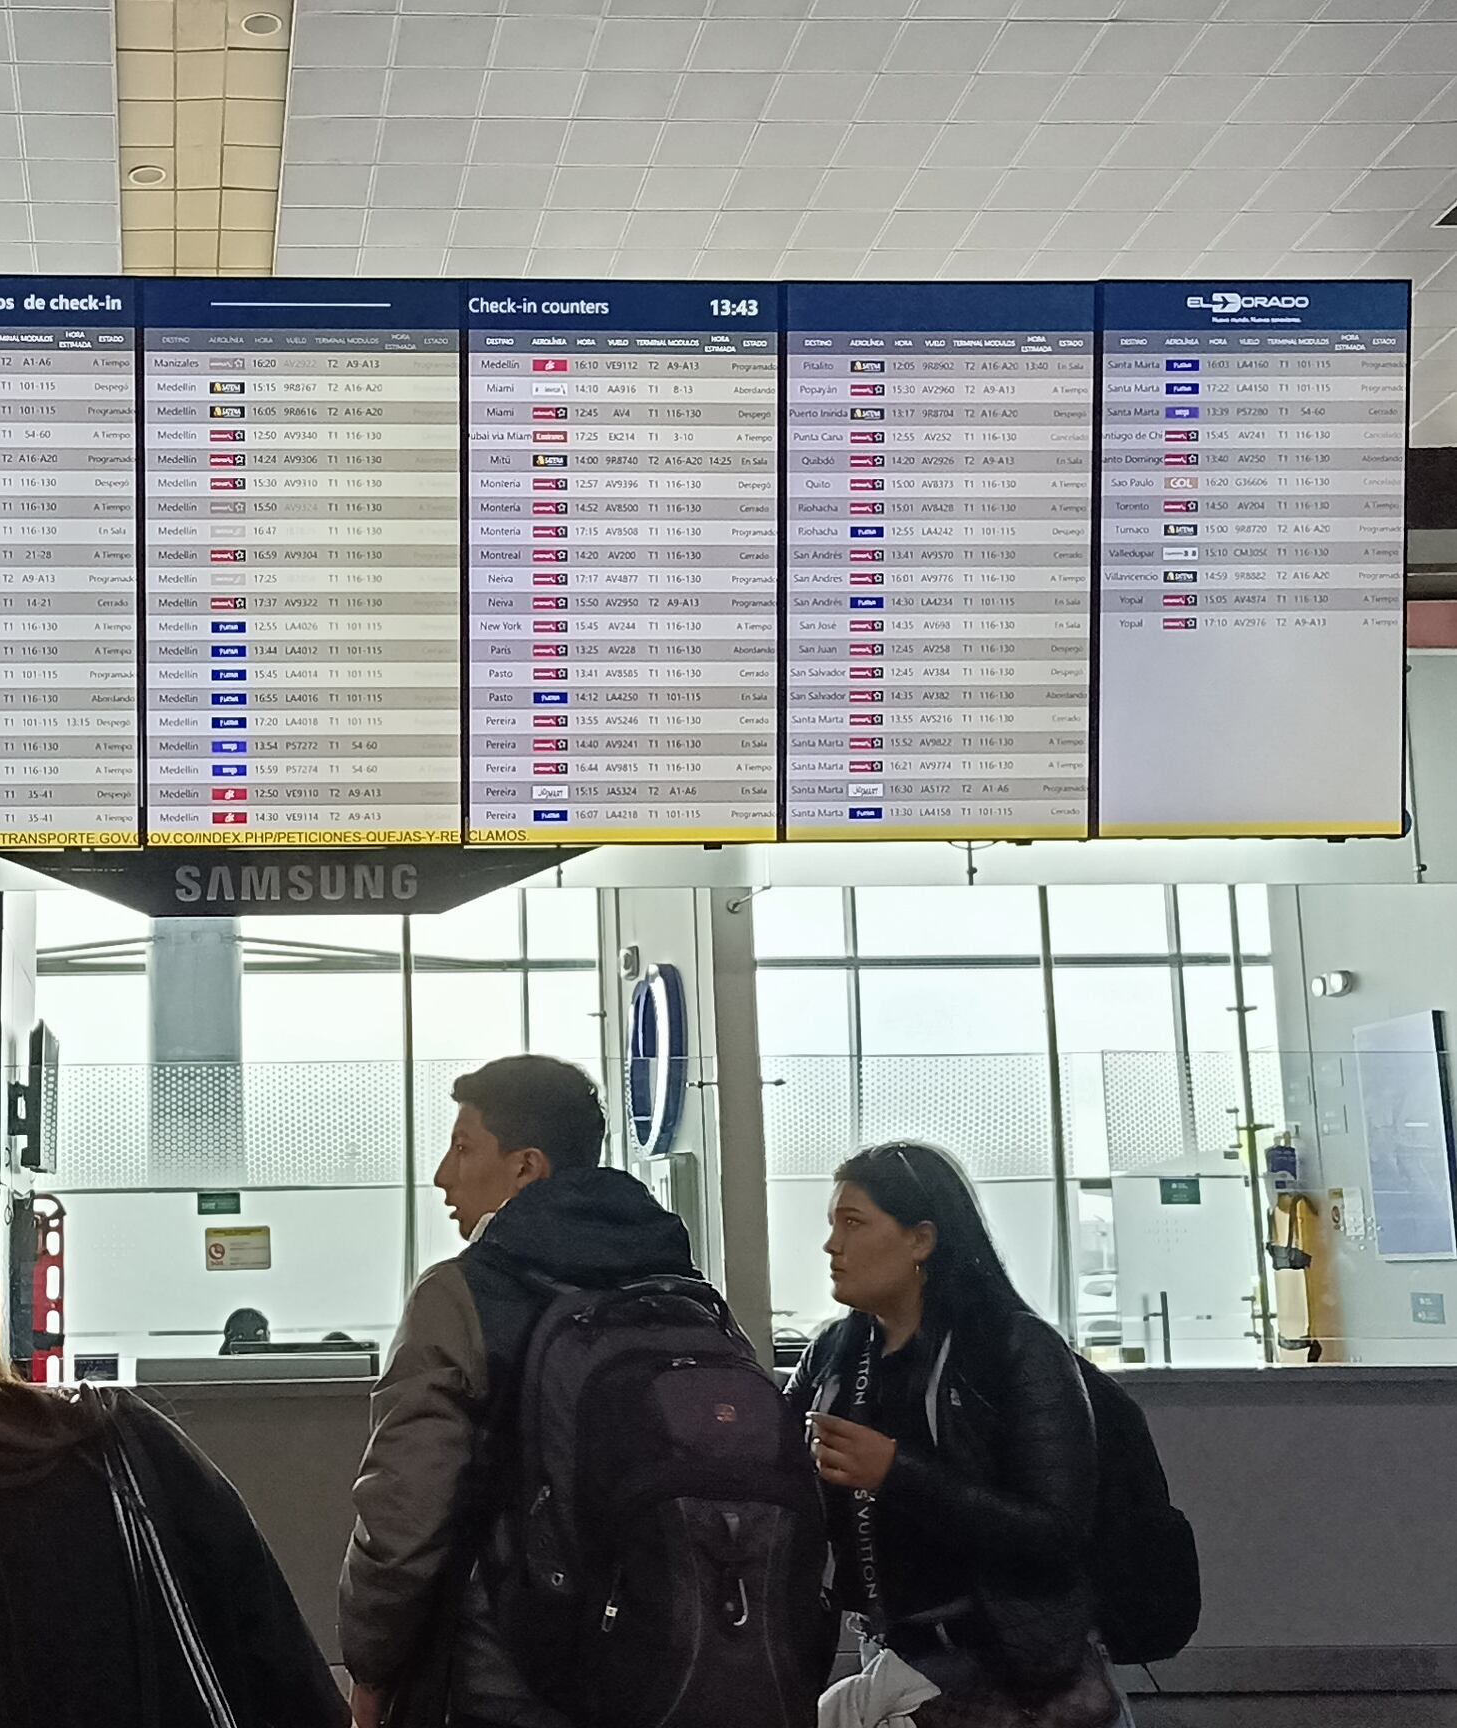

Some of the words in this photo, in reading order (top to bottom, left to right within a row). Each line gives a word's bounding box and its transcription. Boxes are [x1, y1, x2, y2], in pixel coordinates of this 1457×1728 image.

[24, 294, 45, 310] de
[50, 295, 121, 310] check-in
[469, 297, 537, 313] Check-in
[542, 300, 609, 314] counters
[711, 300, 758, 315] 13:43
[1, 358, 11, 366] T2
[23, 358, 51, 366] A1-A6
[155, 359, 199, 367] Manizales
[328, 360, 338, 368] T2
[346, 360, 379, 368] A9-A13
[575, 361, 598, 369] 16:10
[606, 361, 637, 369] VE9112
[649, 361, 659, 370] T2
[667, 362, 699, 370] A9-A13
[804, 362, 833, 370] Pitalito
[893, 362, 915, 370] 12:05
[965, 362, 975, 370] T2
[1108, 361, 1131, 369] Santa
[1280, 360, 1288, 368] T1
[575, 456, 598, 464] 14:00
[648, 456, 659, 465] T2
[665, 457, 702, 465] A16-A20
[710, 457, 731, 465] 14:25
[1130, 479, 1154, 487] Paulo
[1170, 478, 1192, 488] GOL
[1296, 478, 1329, 486] 116-130
[799, 645, 815, 653] San
[818, 645, 837, 653] Juan
[892, 645, 913, 653] 12:45
[5, 742, 14, 750] T1
[23, 743, 58, 751] 116-130
[486, 740, 516, 749] Pereira
[649, 740, 658, 748] T1
[667, 740, 701, 748] 116-130
[255, 789, 278, 797] 12:50
[330, 789, 340, 797] T2
[176, 865, 416, 901] SAMSUNG
